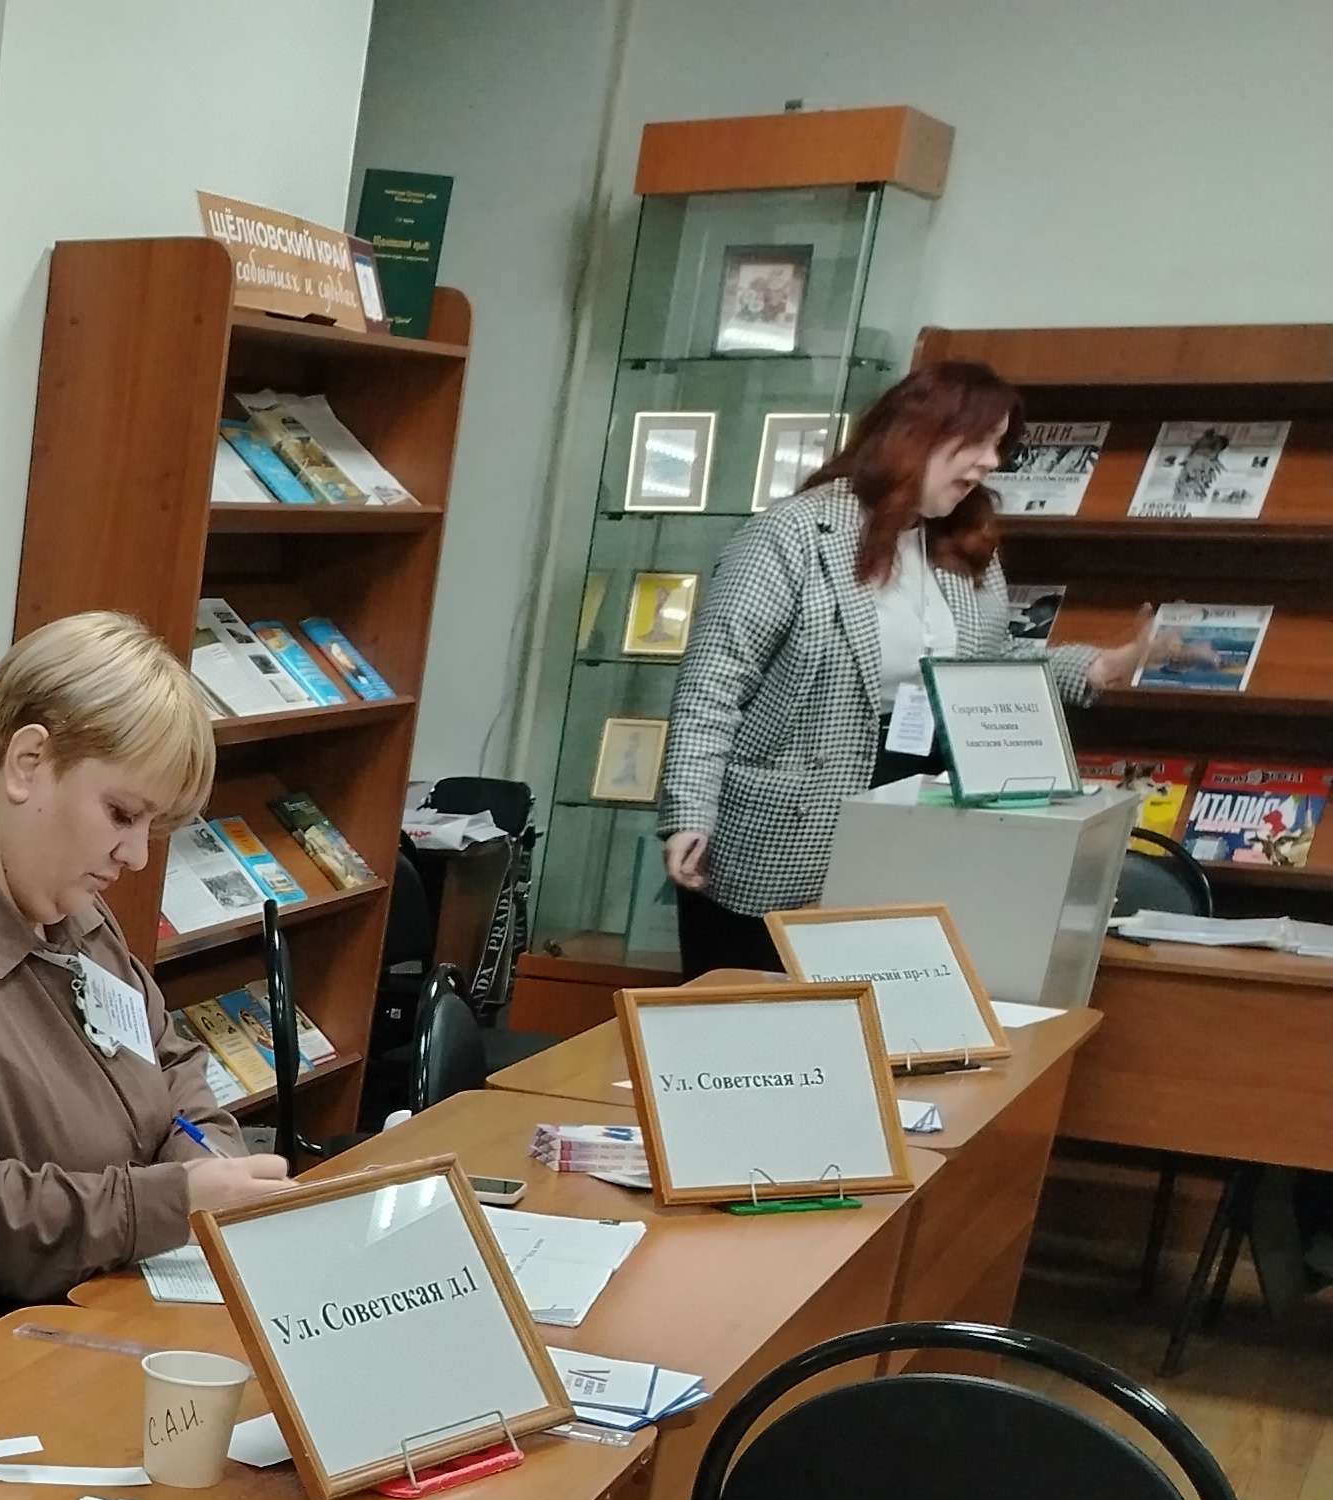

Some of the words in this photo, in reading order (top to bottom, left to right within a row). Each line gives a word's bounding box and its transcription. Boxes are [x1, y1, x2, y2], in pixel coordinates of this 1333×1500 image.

[315, 240, 351, 273] КРАЙ
[660, 1073, 693, 1093] Ул.
[697, 1070, 794, 1091] Советская
[799, 1068, 825, 1090] д.3
[270, 1313, 321, 1345] Ул.
[321, 1278, 445, 1333] Советская
[446, 1266, 480, 1306] д.1
